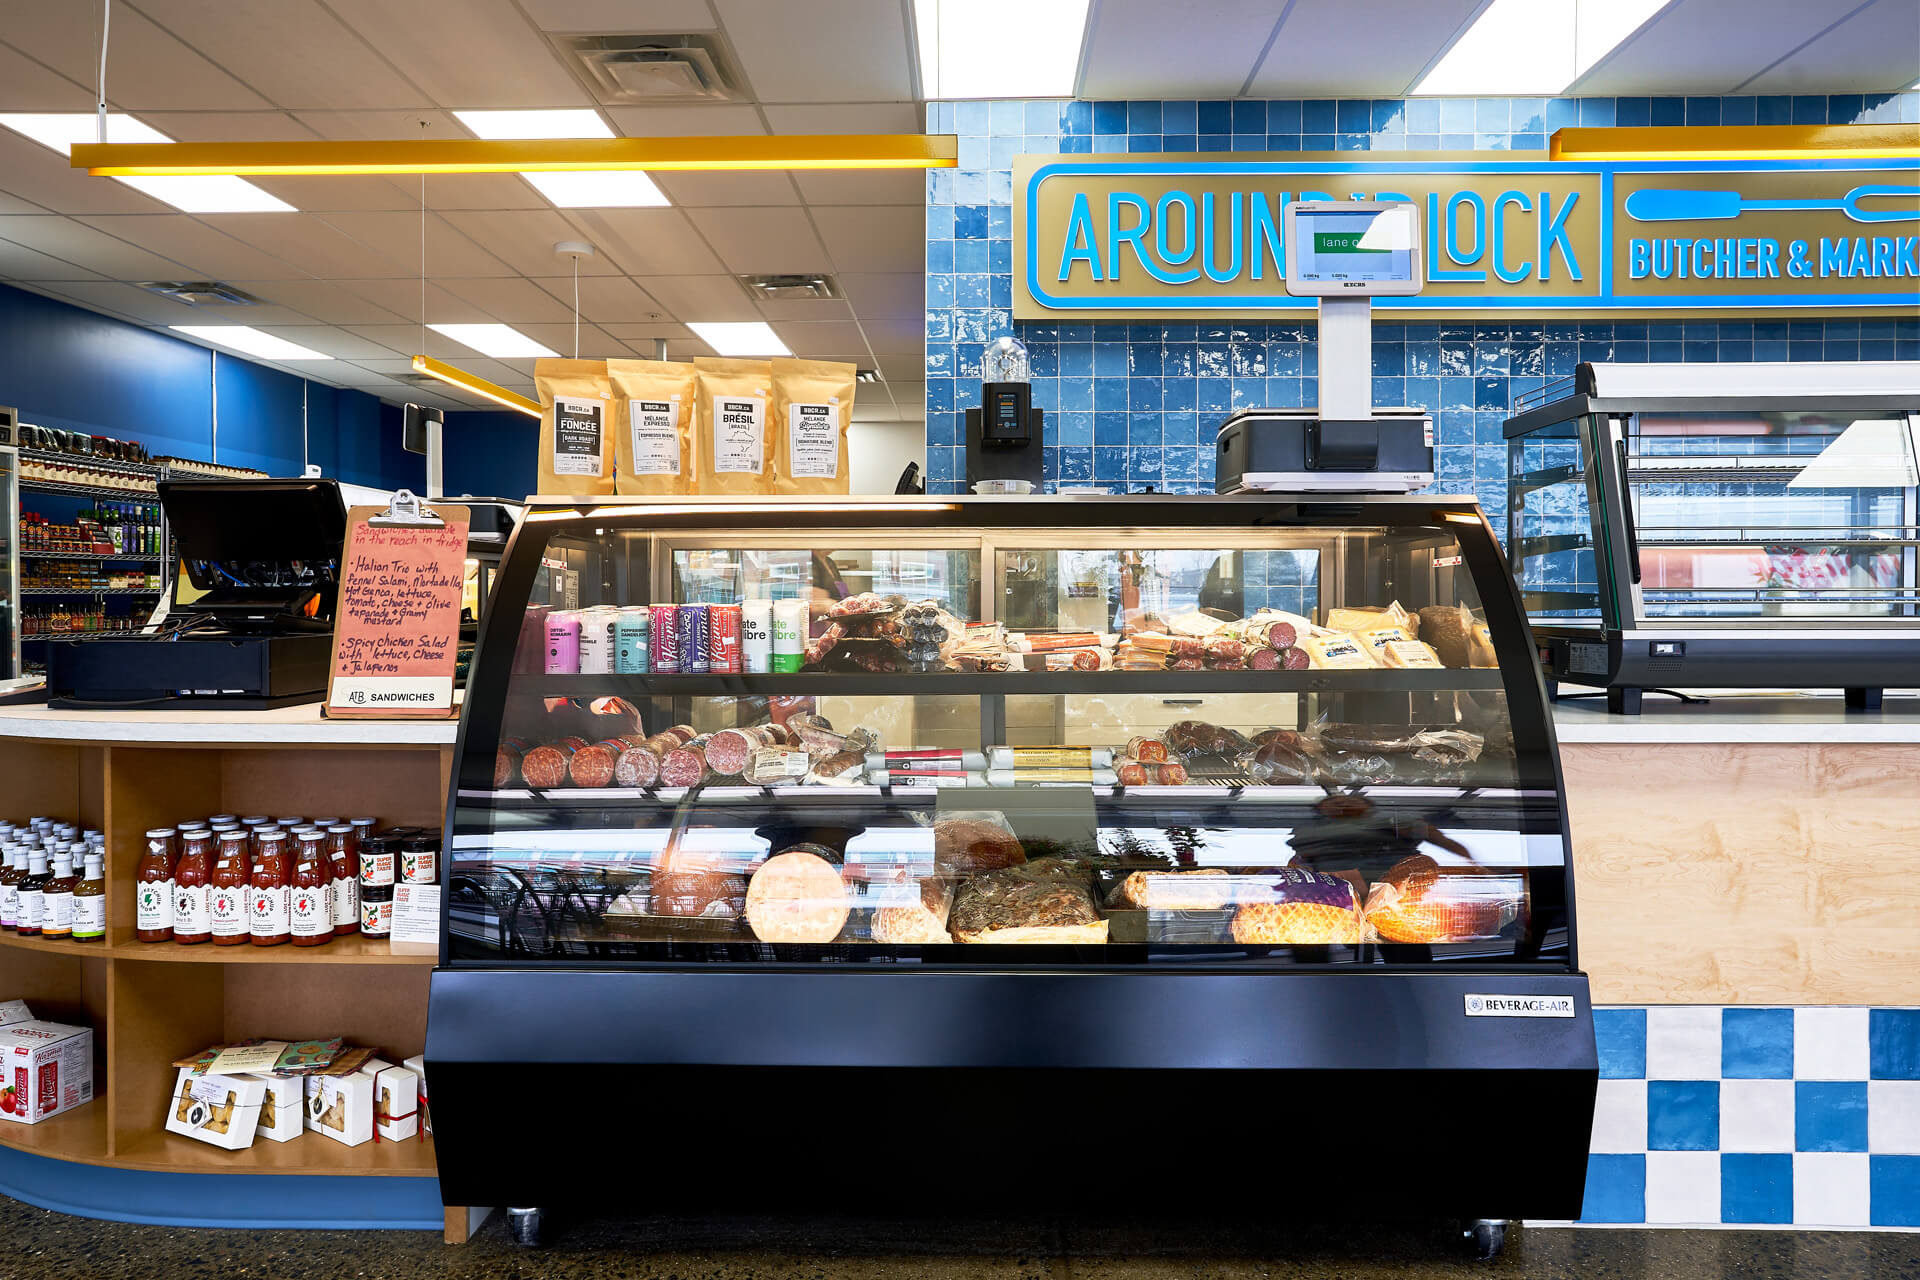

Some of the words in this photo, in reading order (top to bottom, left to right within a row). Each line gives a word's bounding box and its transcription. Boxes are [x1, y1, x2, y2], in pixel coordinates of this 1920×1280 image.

[1058, 190, 1335, 285] AROUN
[1375, 190, 1584, 284] LOCK
[1323, 237, 1348, 247] lane
[1630, 238, 1780, 280] BUTCHER
[1787, 240, 1814, 278] &
[560, 419, 598, 432] FONCÉE
[723, 413, 755, 424] BRÉSIL
[355, 535, 365, 544] in
[369, 534, 385, 545] the
[389, 534, 417, 545] reach
[423, 535, 432, 544] in
[436, 534, 463, 552] fridge
[392, 560, 410, 574] Trio
[416, 562, 439, 574] with
[345, 586, 361, 599] Hot
[742, 619, 757, 629] ate
[774, 620, 787, 629] ate
[346, 637, 375, 651] Spicy
[418, 634, 449, 648] Salad
[661, 609, 679, 662] Karma
[697, 608, 710, 662] Karma
[711, 609, 726, 661] Karma
[339, 648, 362, 660] with
[349, 691, 366, 704] ATB
[370, 693, 435, 701] SANDWICHES
[142, 888, 162, 905] KETCHUP
[178, 893, 197, 911] KETCHUP
[216, 894, 235, 911] KETCHUP
[256, 894, 275, 911] KETCHUP
[297, 893, 315, 911] KETCHUP
[1486, 1000, 1569, 1011] BEVERAGE-AIR
[35, 1048, 62, 1063] Karma
[41, 1066, 56, 1101] Karma
